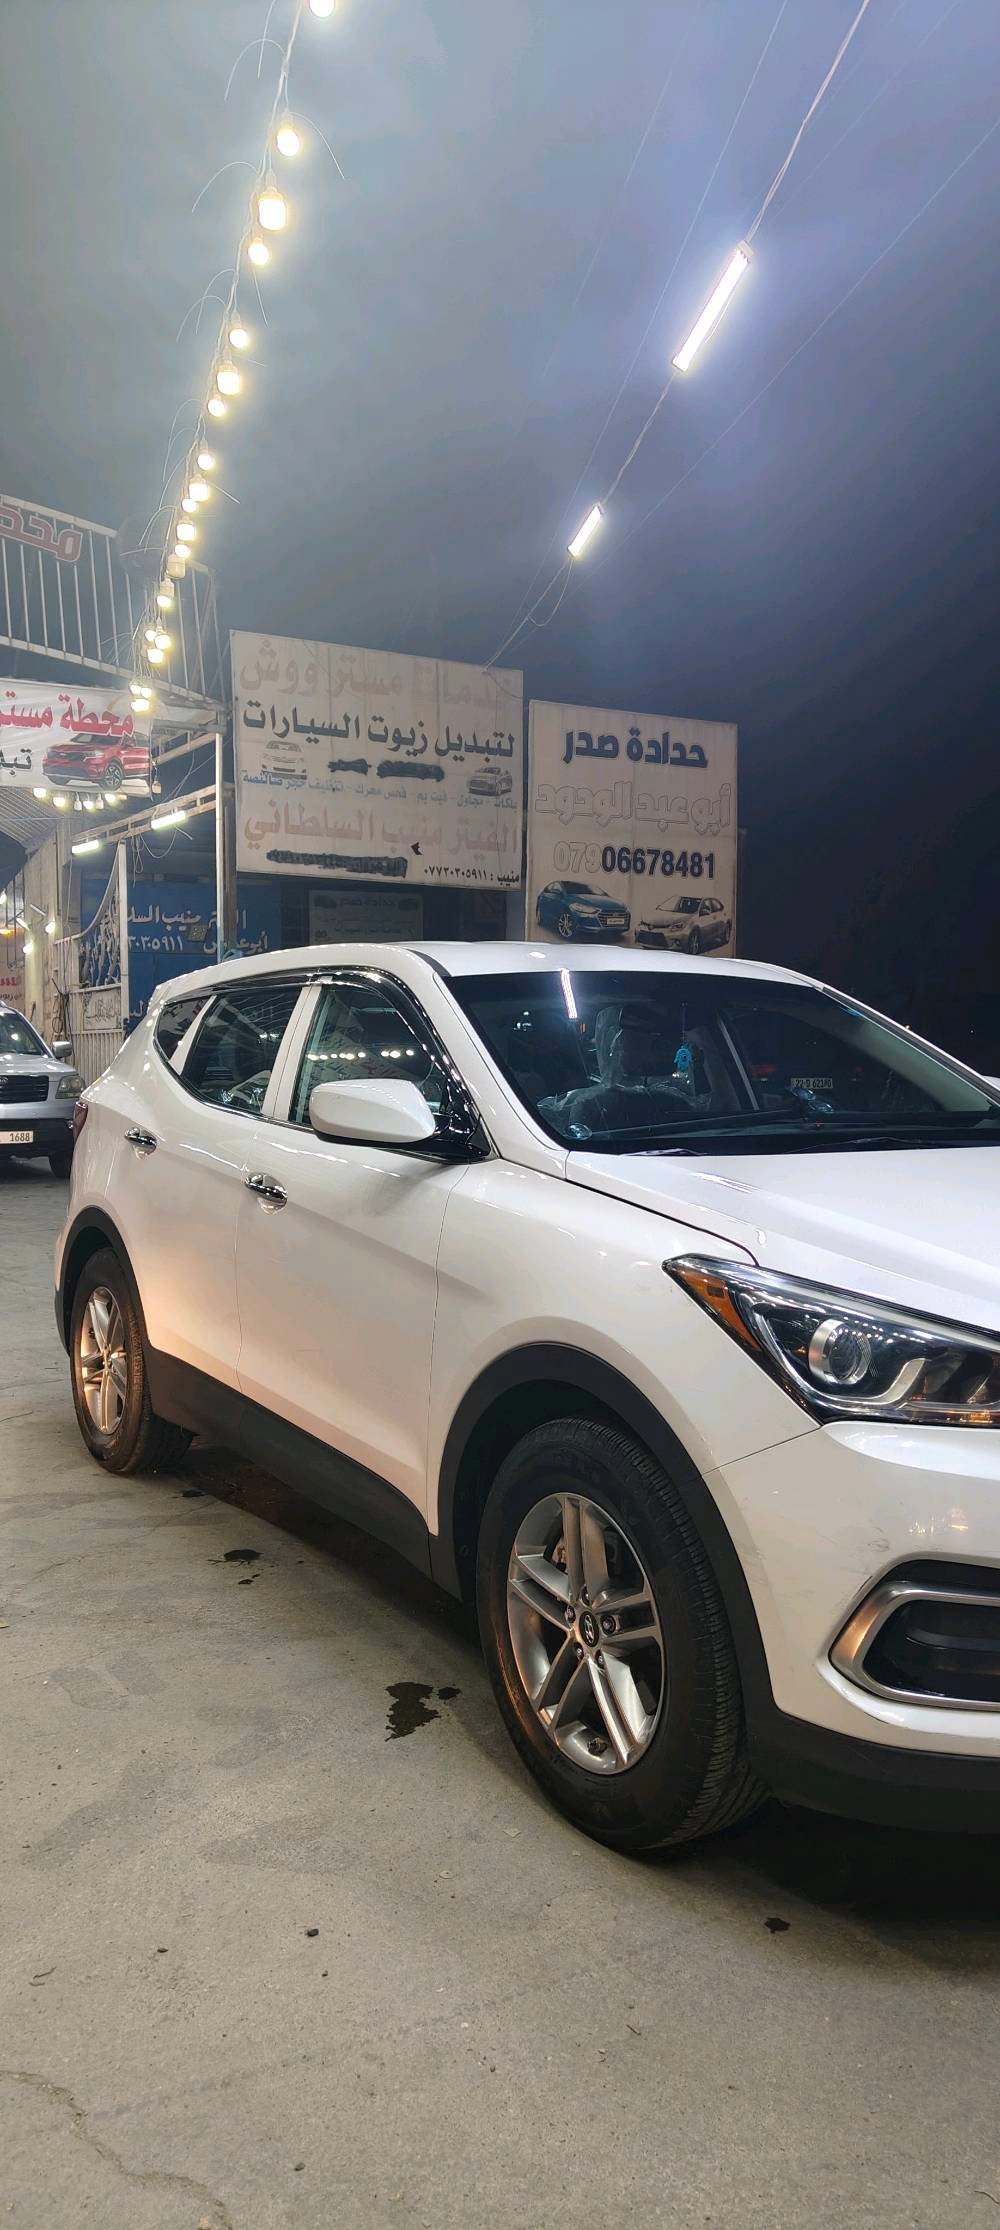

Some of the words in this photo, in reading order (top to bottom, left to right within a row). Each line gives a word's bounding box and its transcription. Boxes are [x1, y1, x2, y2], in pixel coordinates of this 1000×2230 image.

[60, 693, 134, 737] محطة
[243, 698, 361, 745] السيارات
[368, 715, 429, 757] زيوت
[435, 726, 515, 766] لتبديل
[561, 728, 620, 765] صدر
[626, 726, 709, 769] حدادة
[244, 800, 375, 850] السلطاني
[534, 780, 633, 828] الودود
[635, 791, 690, 833] عبد
[690, 783, 732, 837] أبو
[497, 870, 520, 887] منيب
[552, 840, 715, 879] 07906678481
[162, 910, 202, 932] منيب
[10, 1132, 31, 1142] 1688
